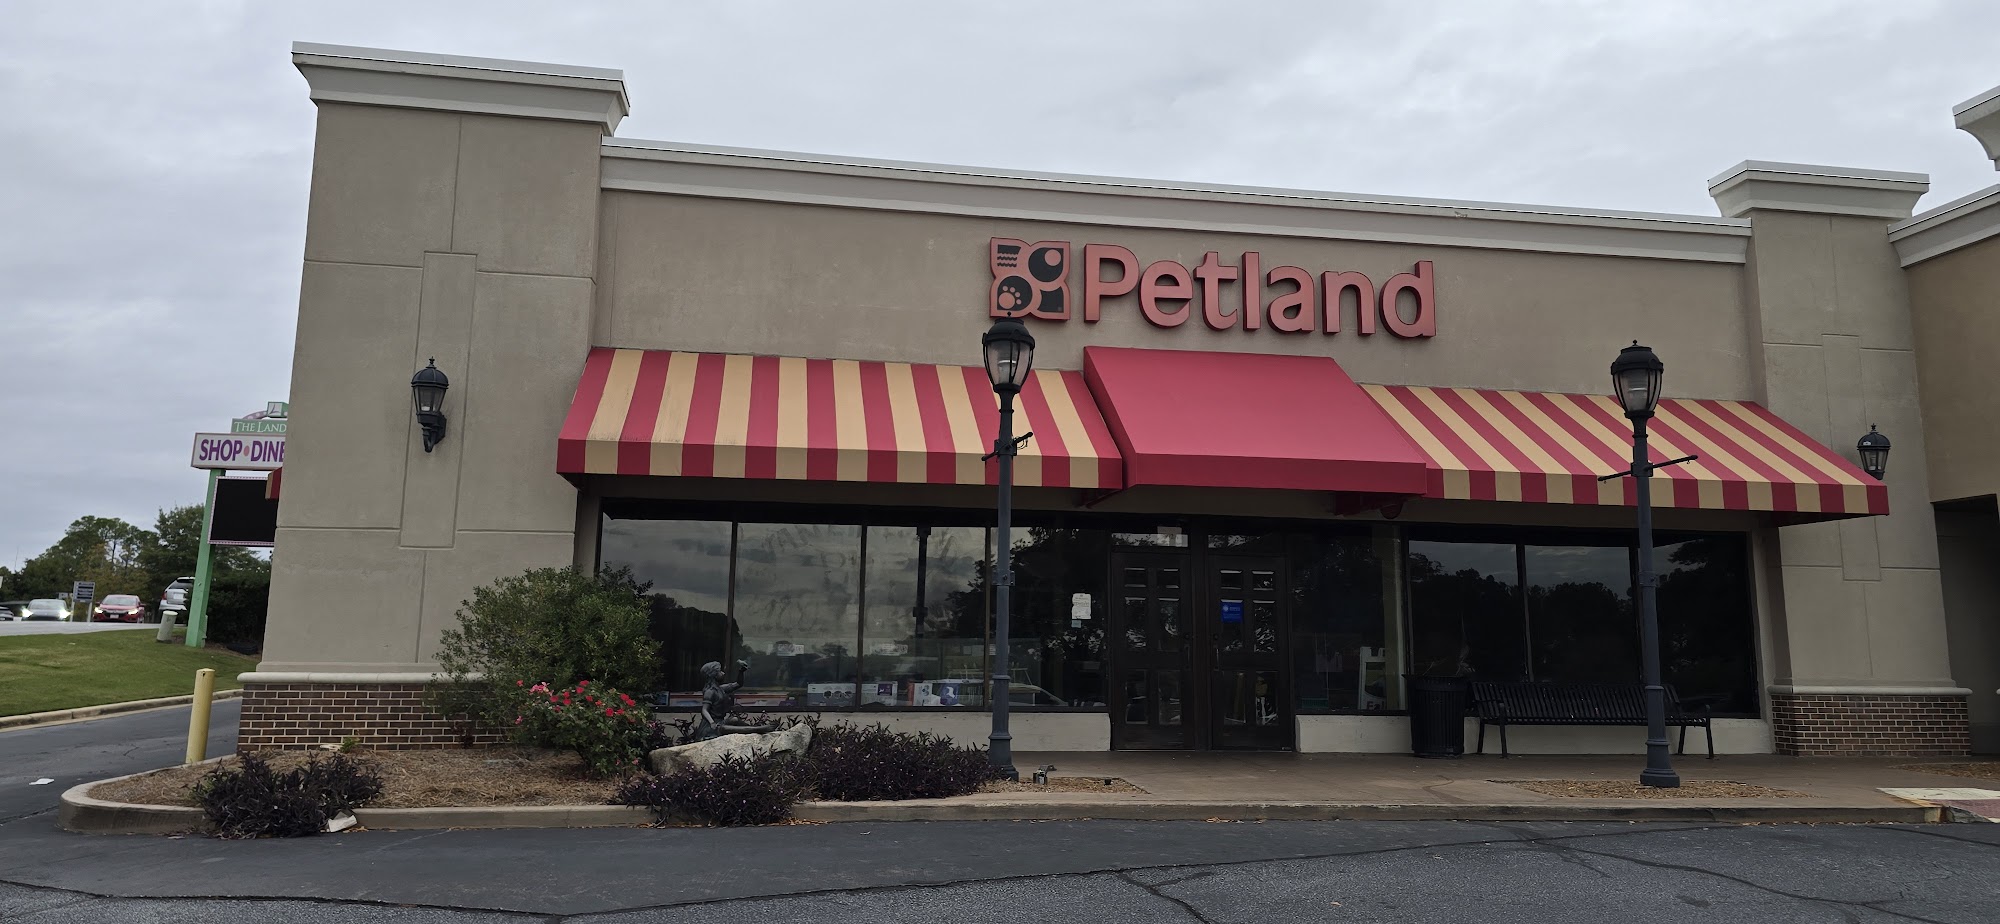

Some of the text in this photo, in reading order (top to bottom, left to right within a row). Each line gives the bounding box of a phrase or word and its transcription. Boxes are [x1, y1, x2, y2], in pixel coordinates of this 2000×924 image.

[1083, 243, 1437, 339] Petland
[234, 422, 255, 432] THE
[199, 439, 242, 461] SHOP
